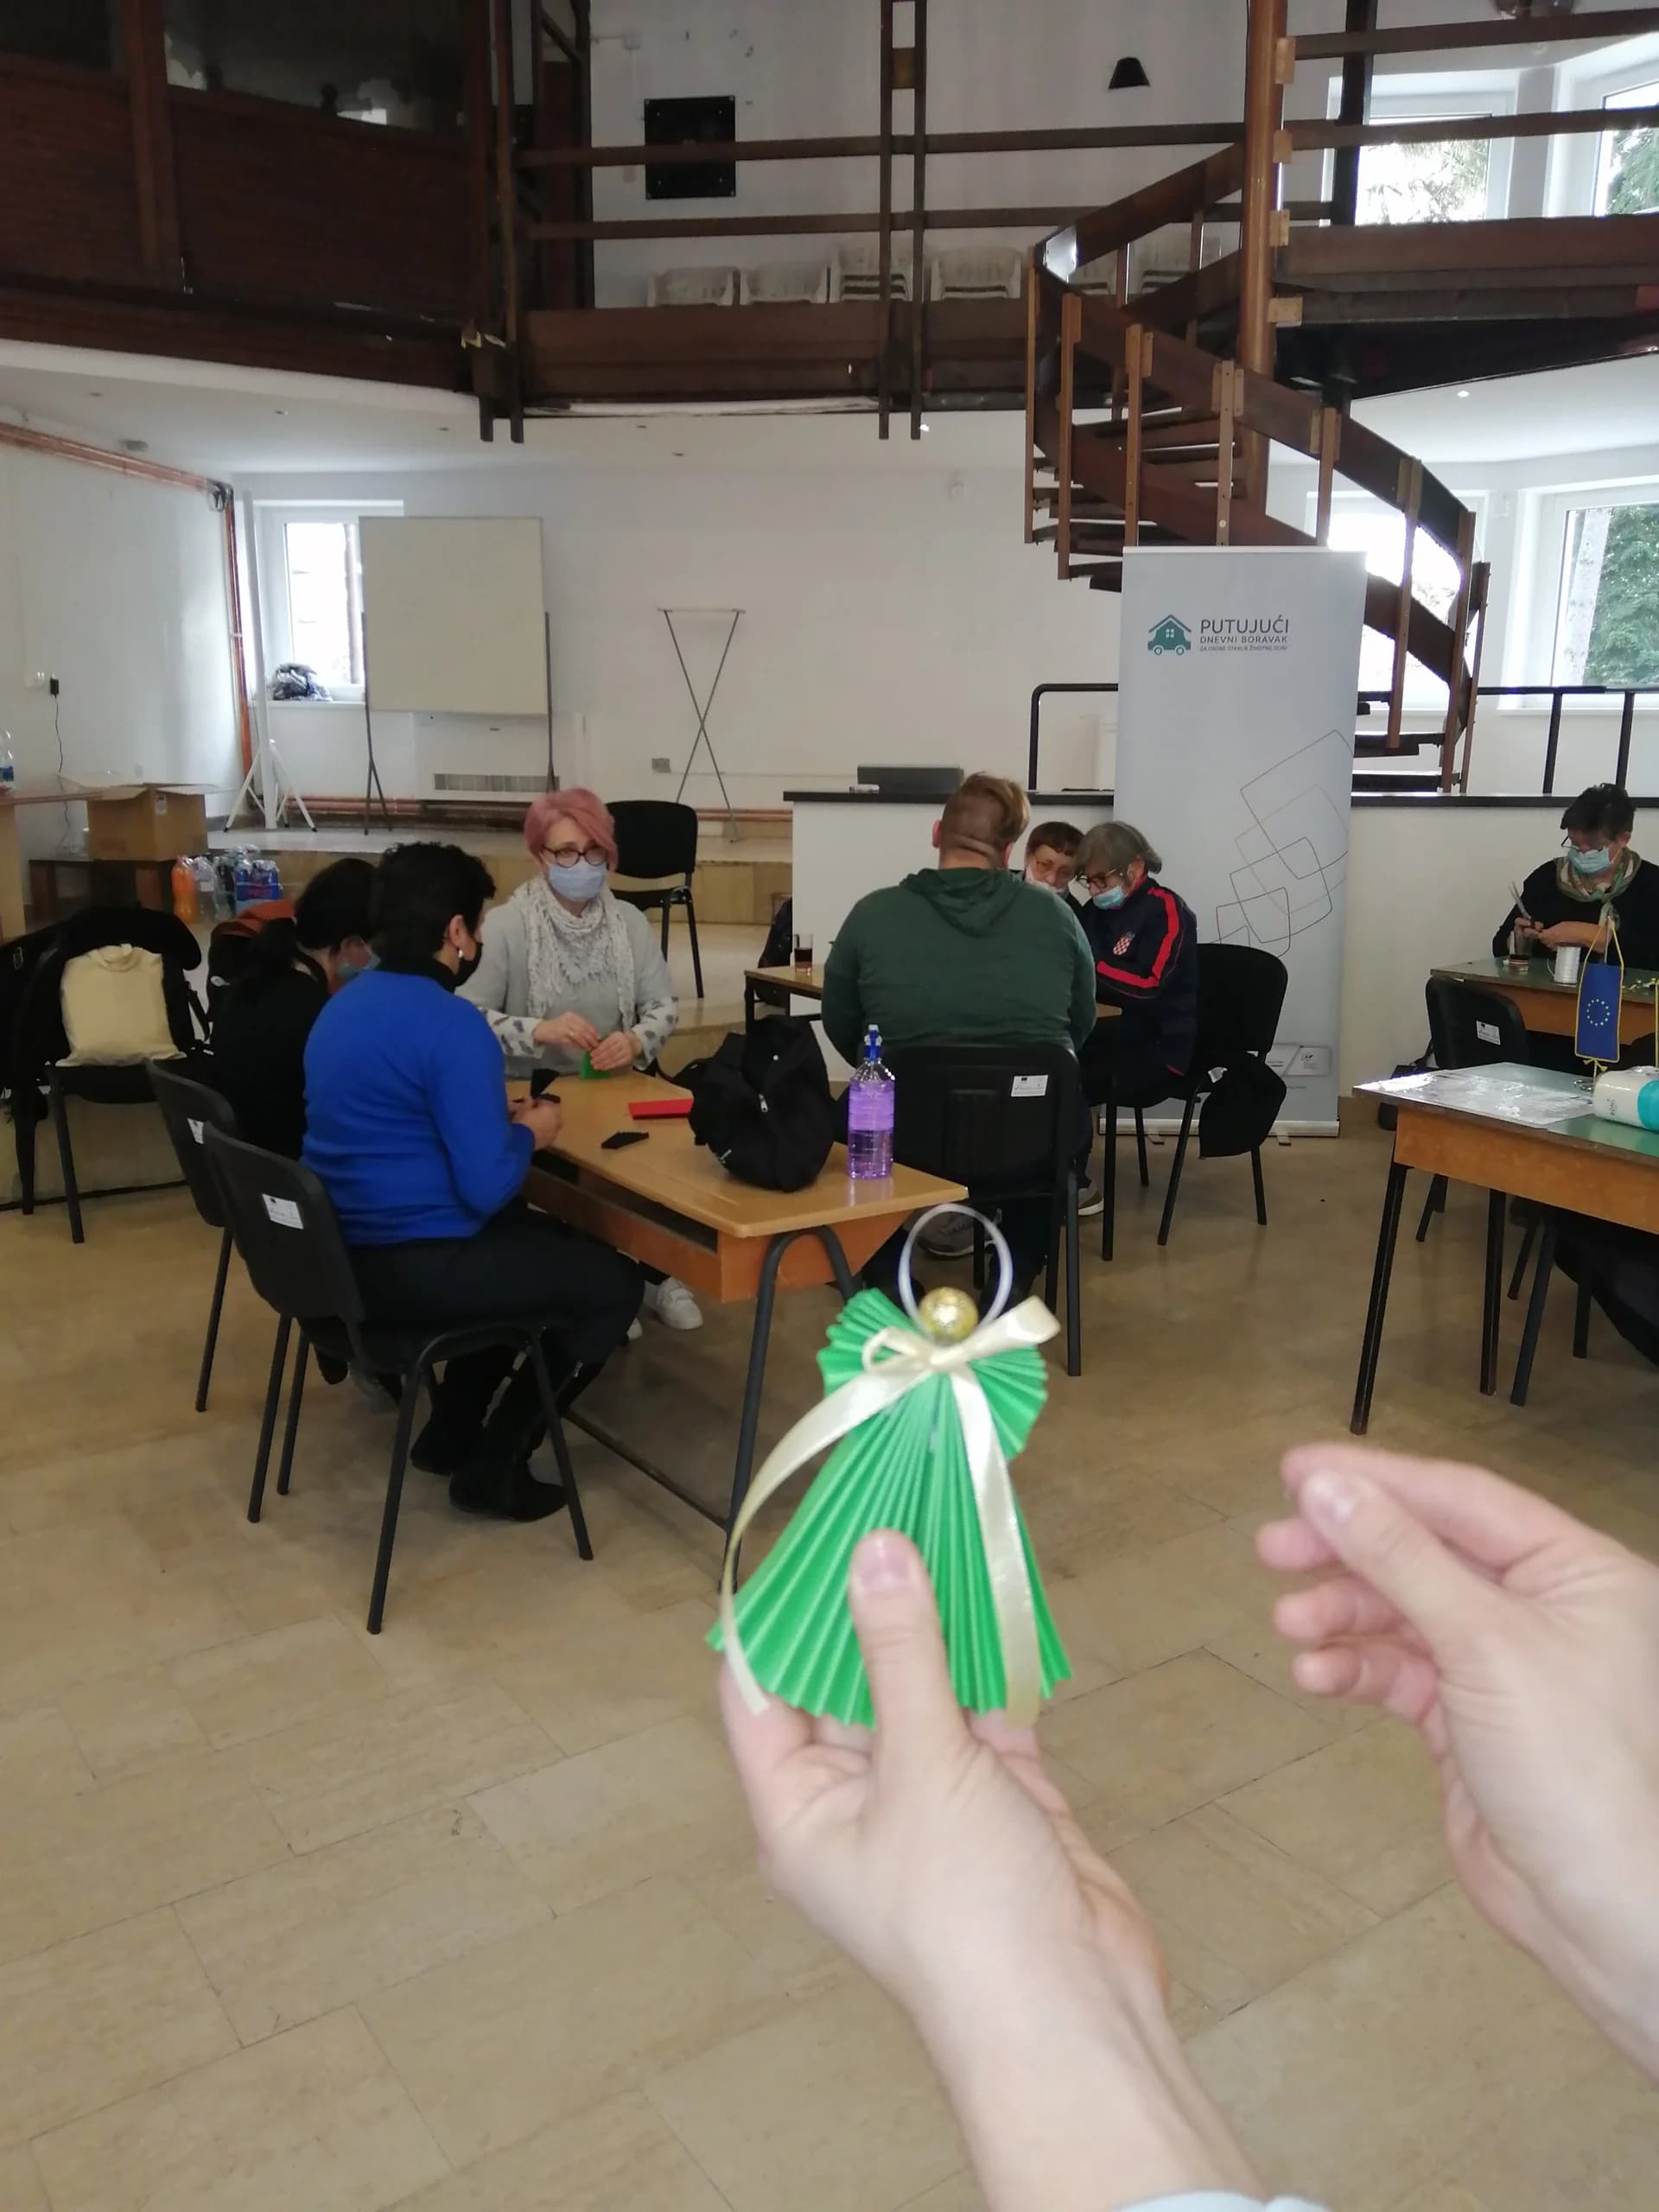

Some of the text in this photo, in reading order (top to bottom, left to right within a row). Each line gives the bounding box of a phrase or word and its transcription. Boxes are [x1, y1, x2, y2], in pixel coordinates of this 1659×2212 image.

[1200, 614, 1289, 634] PUTUJUĆI
[1199, 635, 1287, 644] DNEVNI BORAVAK
